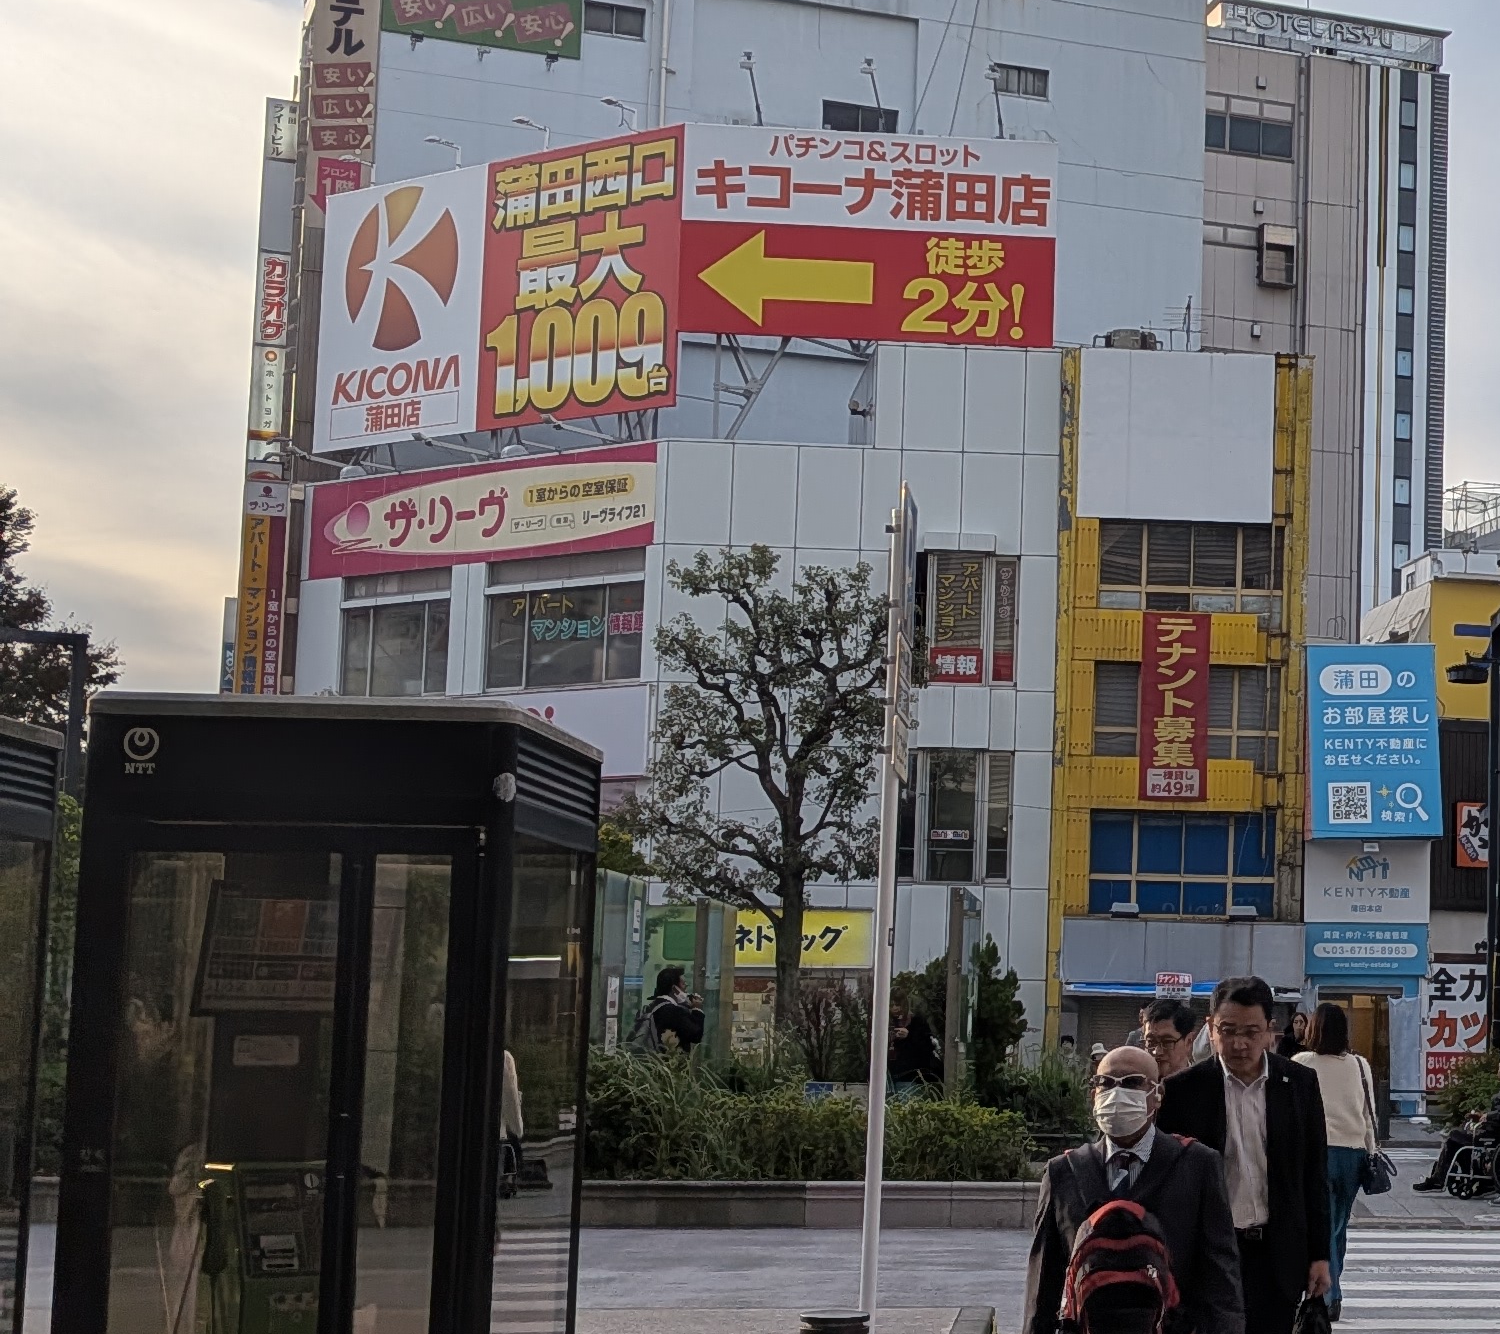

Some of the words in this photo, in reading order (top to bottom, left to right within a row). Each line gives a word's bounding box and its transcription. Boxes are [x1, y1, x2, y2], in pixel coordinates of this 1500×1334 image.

[1231, 4, 1323, 37] HOTEL
[769, 135, 981, 167] パチンコ&スロット
[493, 138, 677, 231] 蒲田西口
[696, 158, 1050, 227] キコーナ蒲田店
[515, 212, 645, 312] 最大
[926, 236, 1005, 277] 徒歩
[261, 257, 288, 341] カラオケ
[901, 279, 1024, 340] 2分!
[331, 355, 461, 406] KICONA
[263, 369, 275, 429] ホットヨガ
[364, 397, 421, 433] 蒲田店
[528, 478, 629, 503] 1室からの空室保証
[513, 593, 574, 616] アパート
[961, 563, 979, 618] アパート
[937, 574, 956, 641] マンション
[531, 615, 607, 641] マンション
[936, 654, 977, 675] 情報
[1153, 617, 1197, 768] テナント募集
[1323, 706, 1430, 725] お部屋探し
[1324, 738, 1427, 750] KENTY不動産に
[1324, 753, 1421, 766] お任せください。
[124, 762, 156, 775] NTT
[1150, 781, 1195, 796] 約49坪
[1323, 887, 1410, 899] KENTY不動産
[735, 924, 849, 953] ネドッグ
